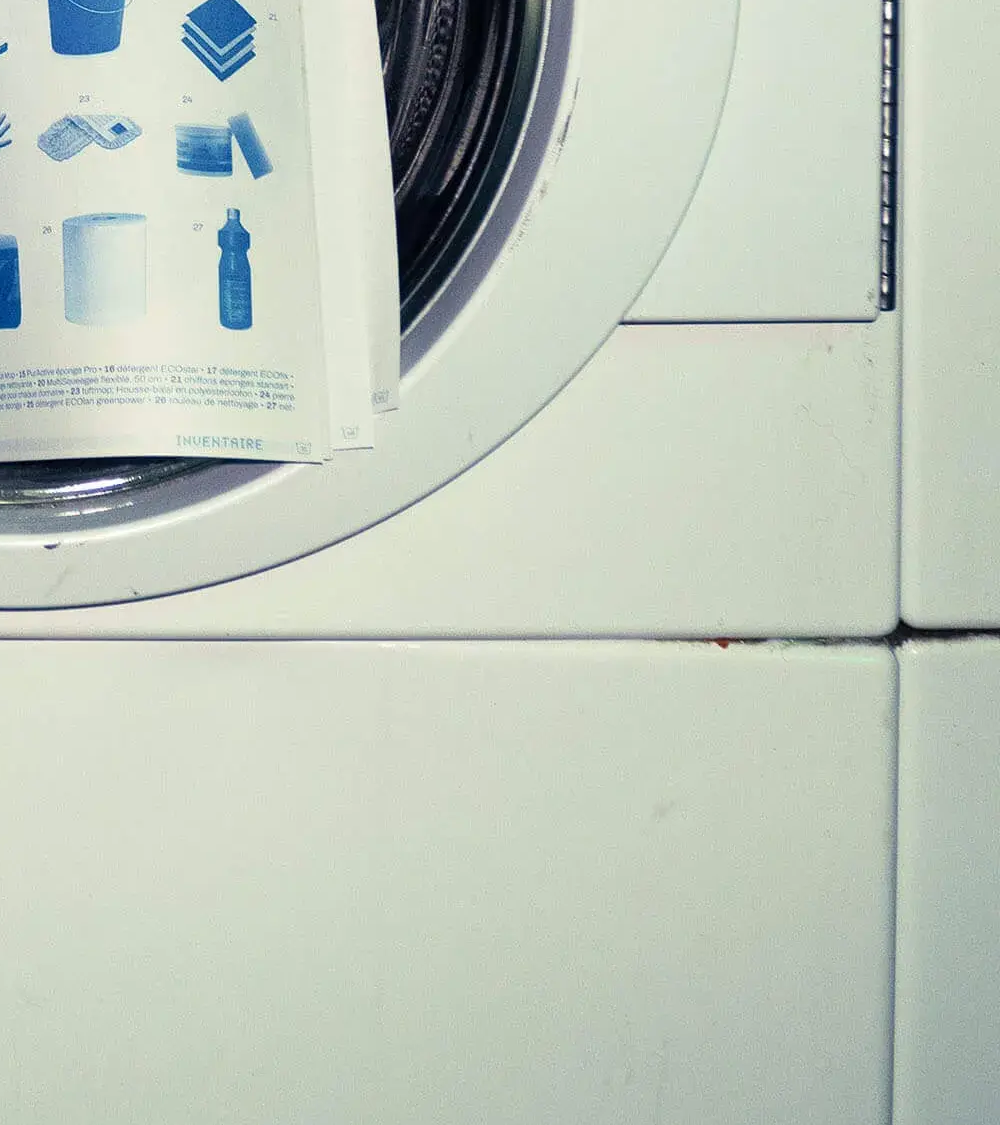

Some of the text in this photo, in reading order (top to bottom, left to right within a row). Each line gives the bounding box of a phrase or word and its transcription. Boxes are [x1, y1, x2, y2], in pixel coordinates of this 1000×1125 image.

[105, 364, 115, 373] 16
[207, 366, 217, 375] 17
[70, 387, 80, 395] 23
[266, 401, 277, 410] 27
[176, 434, 264, 451] INVENTAIRE
